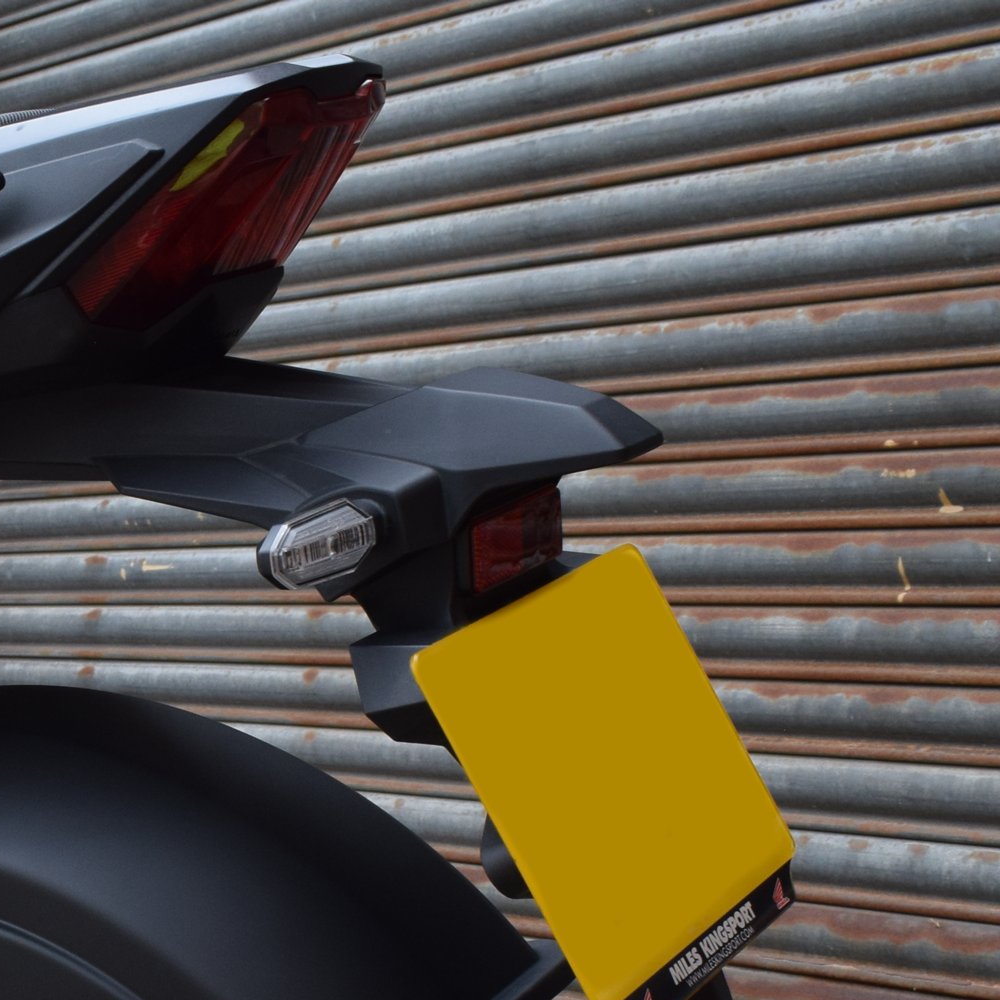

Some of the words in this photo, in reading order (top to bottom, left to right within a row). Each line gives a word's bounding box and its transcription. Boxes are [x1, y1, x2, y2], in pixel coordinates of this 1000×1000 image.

[668, 947, 703, 986] MILES
[699, 900, 756, 959] KINGSPORT
[685, 925, 756, 987] WWW.MILESKINGSPORT.COM
